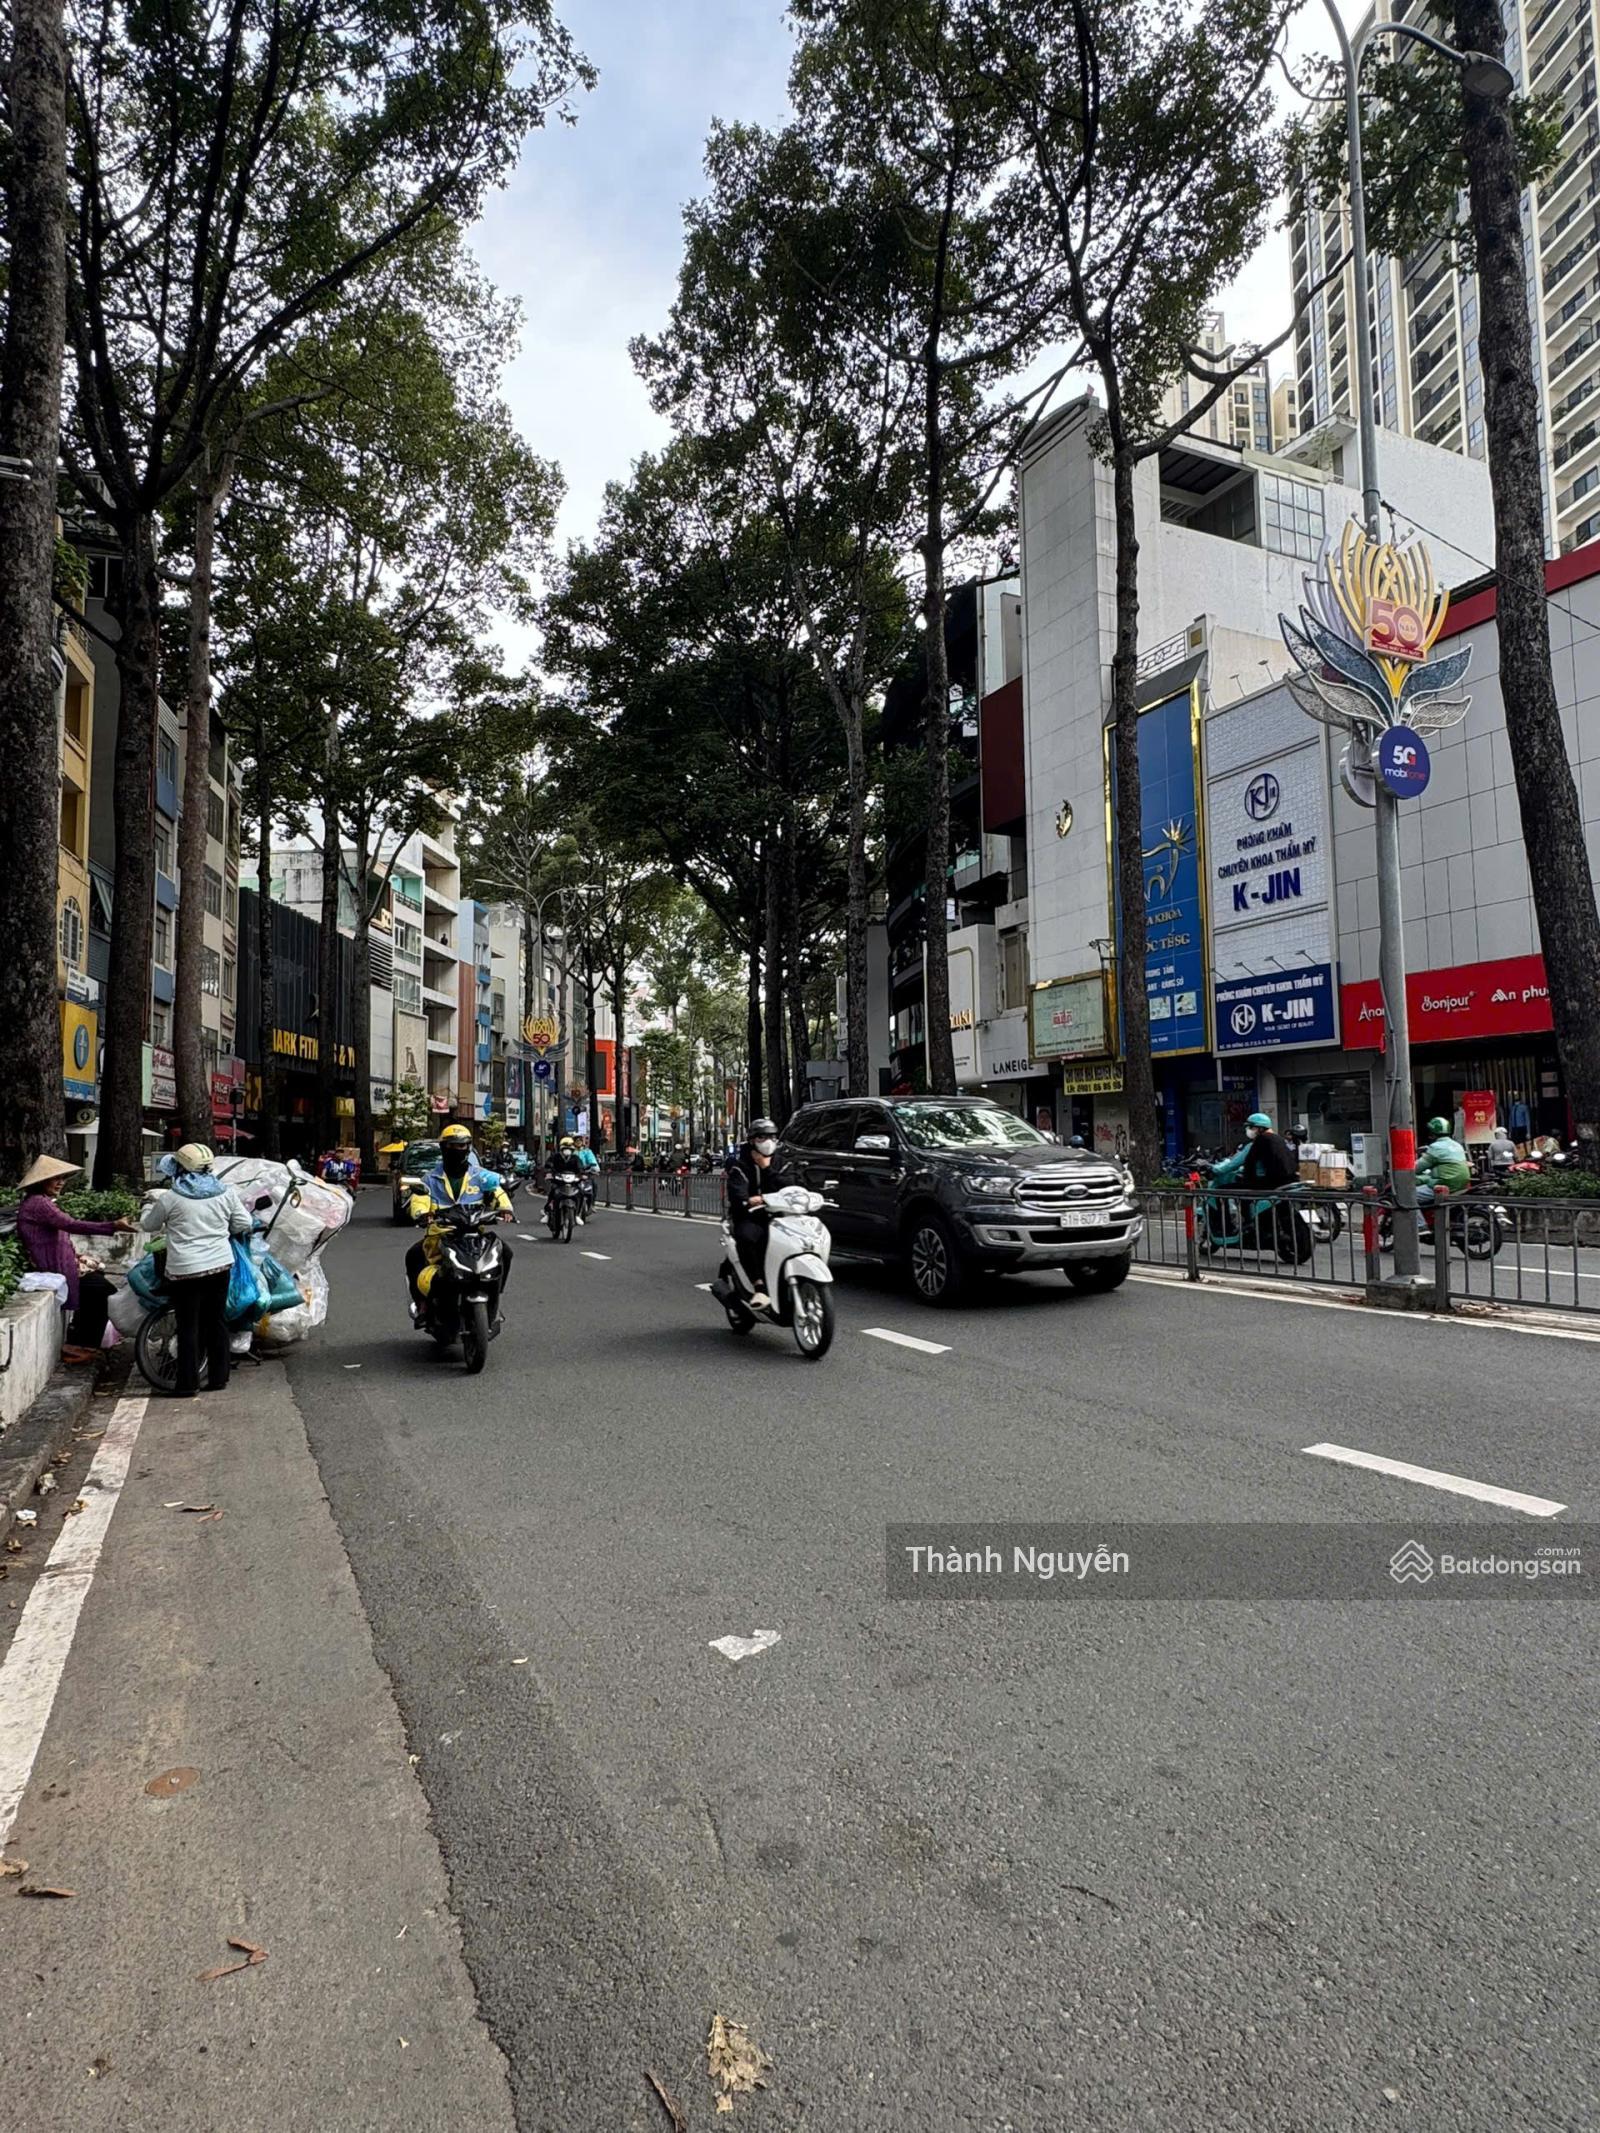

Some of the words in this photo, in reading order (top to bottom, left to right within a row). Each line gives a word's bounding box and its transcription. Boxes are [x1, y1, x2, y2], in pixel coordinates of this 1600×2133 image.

[1371, 600, 1424, 650] 50
[1392, 744, 1417, 766] 5G
[1250, 852, 1275, 869] KHOA
[1261, 997, 1314, 1023] K-JIN
[1421, 995, 1470, 1013] Bonjour
[533, 1033, 550, 1044] 50
